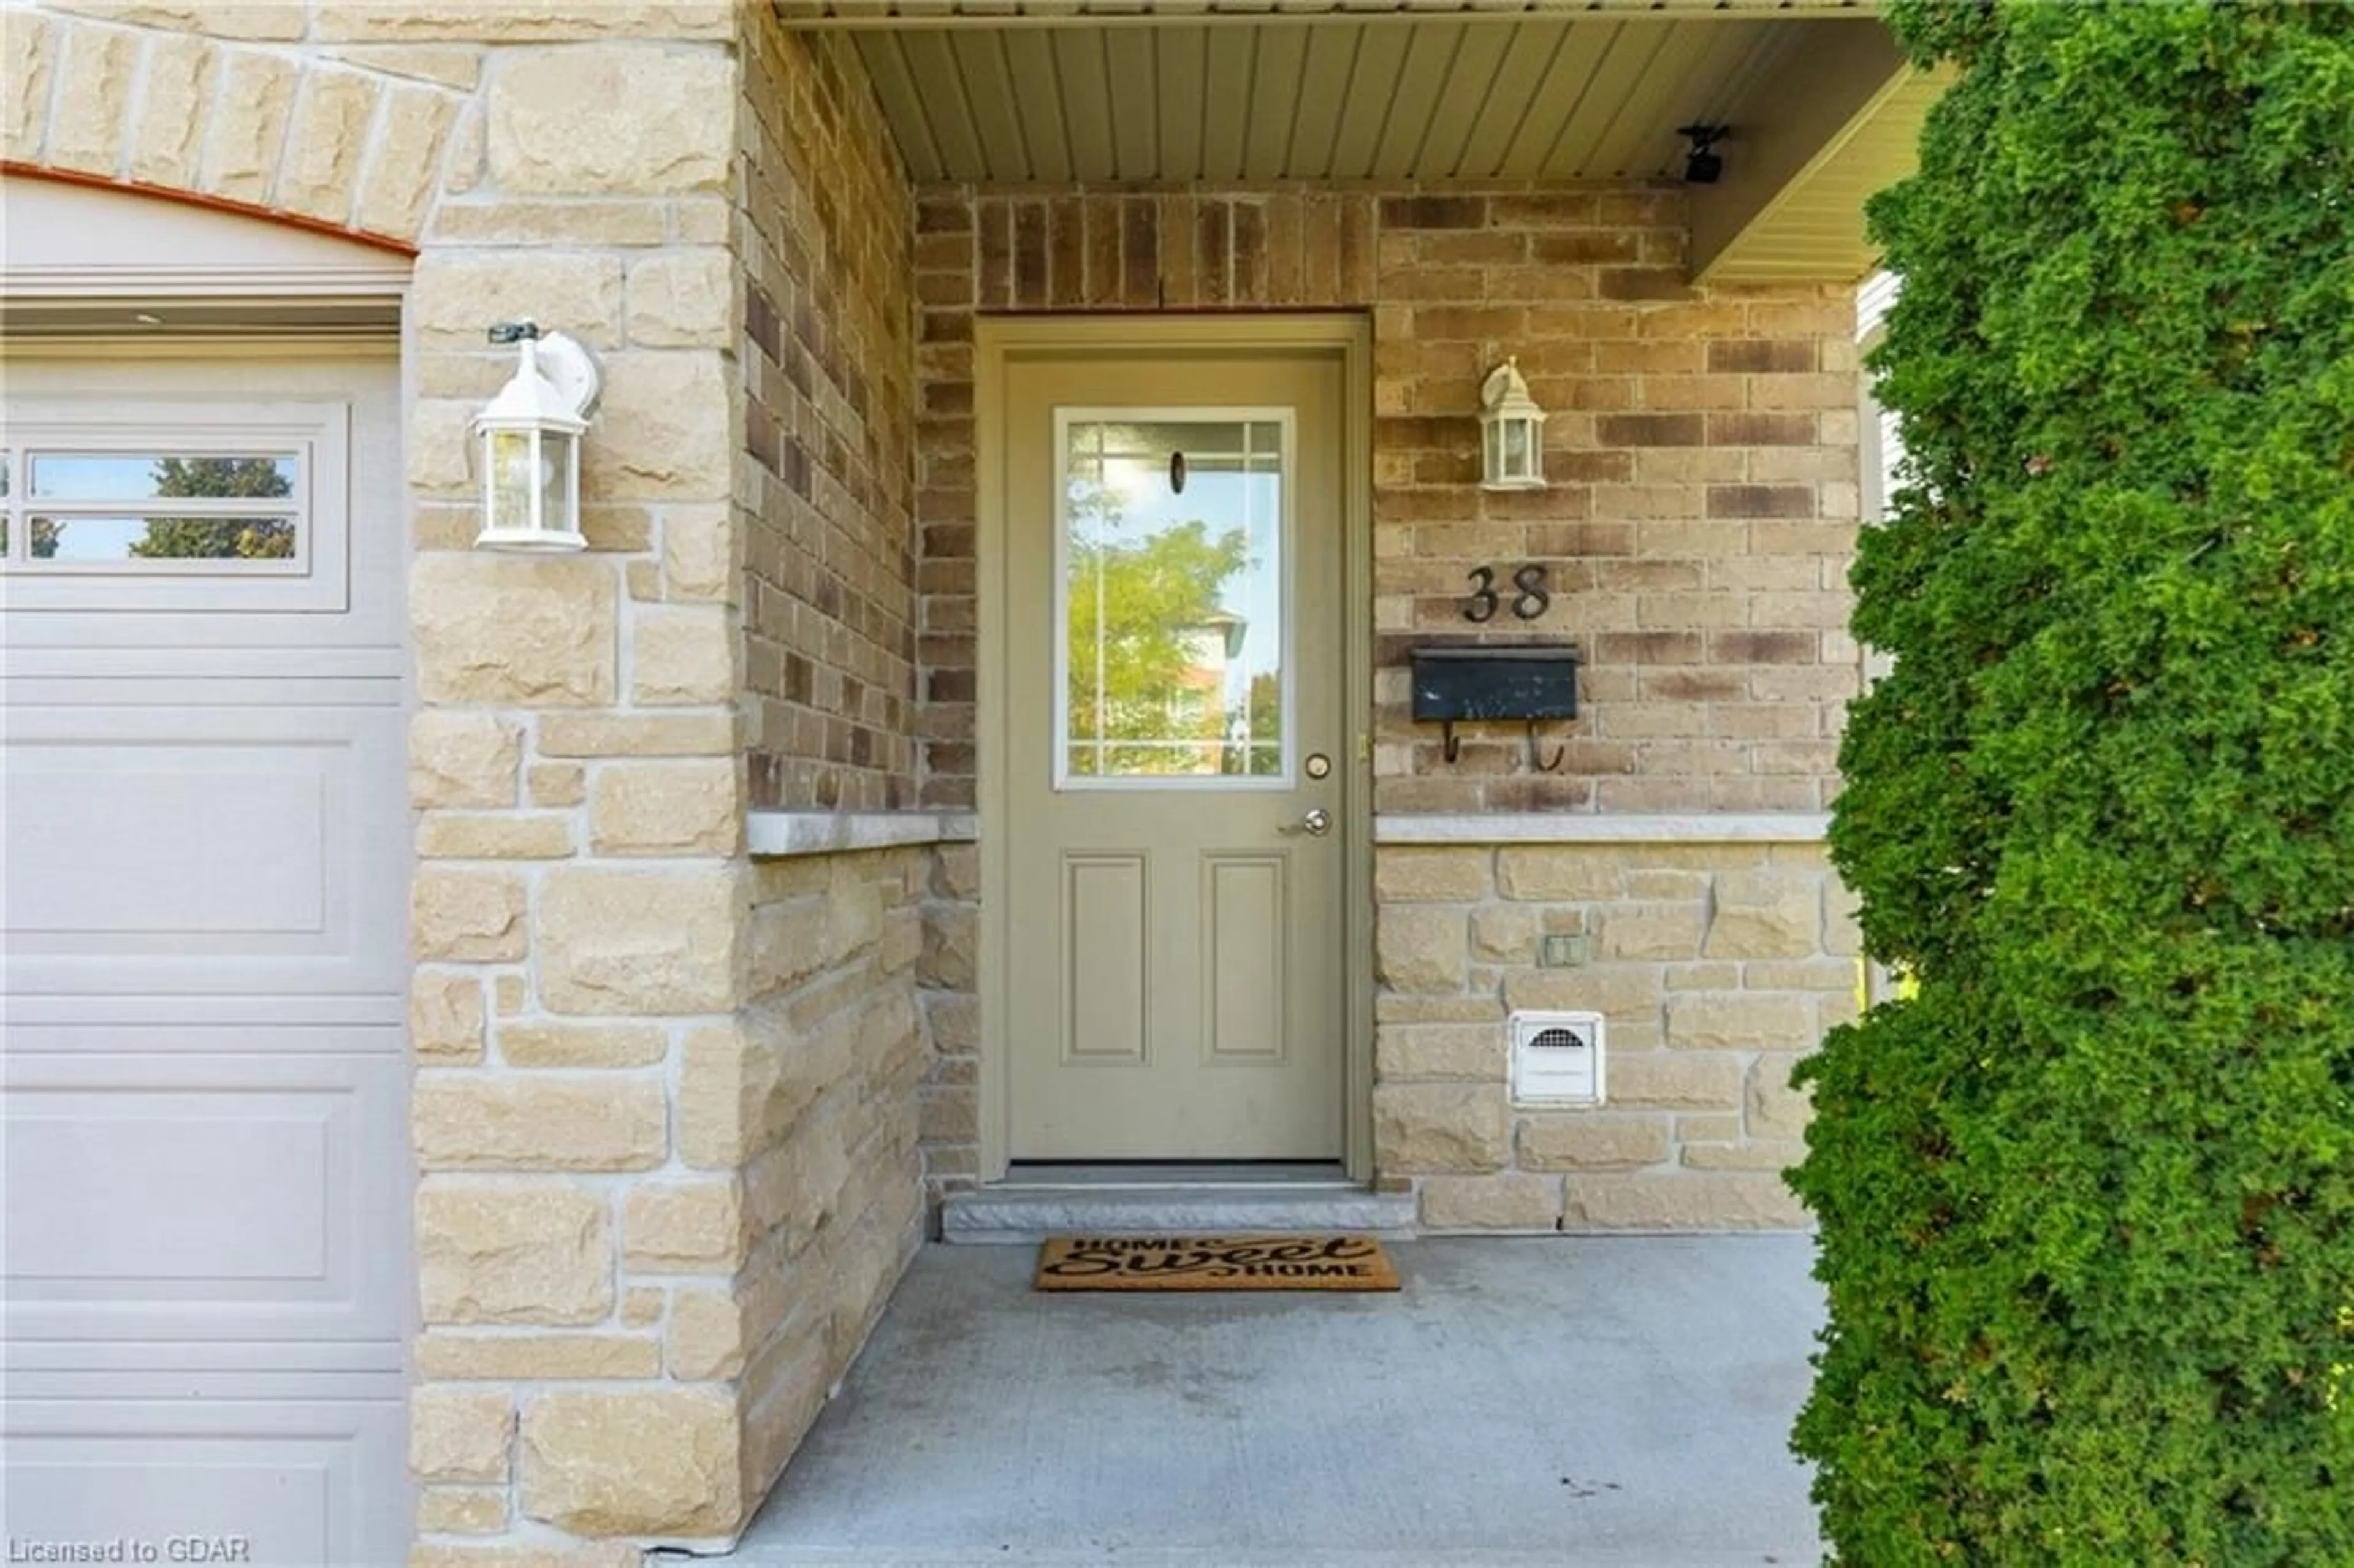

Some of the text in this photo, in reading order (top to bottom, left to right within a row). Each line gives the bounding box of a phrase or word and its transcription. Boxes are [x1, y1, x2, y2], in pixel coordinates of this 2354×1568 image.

[1463, 565, 1550, 623] 38
[1044, 1237, 1376, 1276] Sweet
[1073, 1239, 1189, 1250] HOME
[1243, 1264, 1373, 1276] HOME
